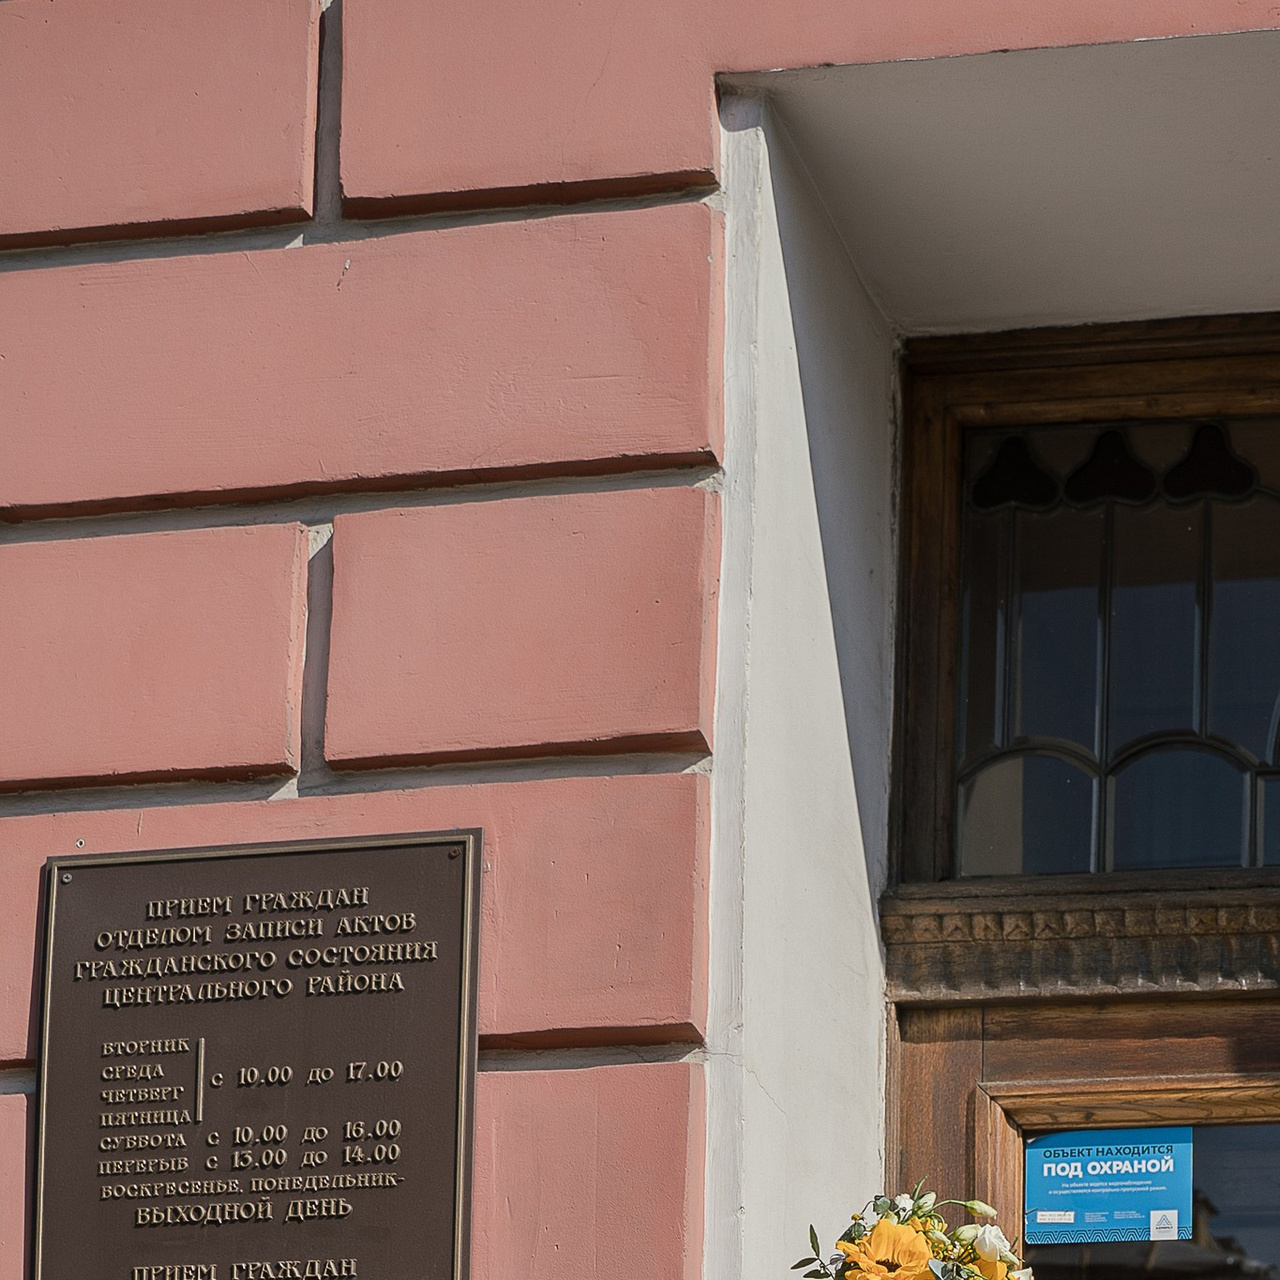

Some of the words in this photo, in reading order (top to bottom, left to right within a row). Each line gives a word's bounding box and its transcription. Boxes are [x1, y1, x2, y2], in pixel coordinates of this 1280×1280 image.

[147, 896, 232, 920] ПРИЕМ
[243, 886, 370, 911] ГРАЖДАН
[96, 925, 212, 950] ОТДЕЛОМ
[225, 917, 325, 941] ЗАПИСИ
[336, 912, 416, 935] АКТОВ
[74, 950, 277, 980] ГРАЖДАНСКОГО
[287, 941, 438, 966] СОСТОЯНИЯ
[103, 978, 293, 1009] ЦЕНТРАЛЬНОГО
[307, 969, 405, 996] РАЙОНА
[102, 1063, 165, 1081] СРЕДА
[237, 1065, 293, 1085] 10.00
[347, 1060, 404, 1081] 17.00
[100, 1109, 192, 1126] ПЯТНИЦА
[100, 1133, 187, 1150] СУББОТА
[233, 1124, 288, 1144] 10.00
[344, 1119, 402, 1141] 16.00
[231, 1148, 288, 1168] 13.00
[343, 1143, 401, 1163] 14.00
[1043, 1148, 1093, 1158] ОБЪЕКТ
[1095, 1145, 1174, 1157] НАХОДИТСЯ
[1042, 1162, 1083, 1179] ПОД
[1087, 1156, 1174, 1176] ОХРАНОЙ
[136, 1197, 273, 1225] ВЫХОДНОЙ
[285, 1198, 354, 1222] ДЕНЬ
